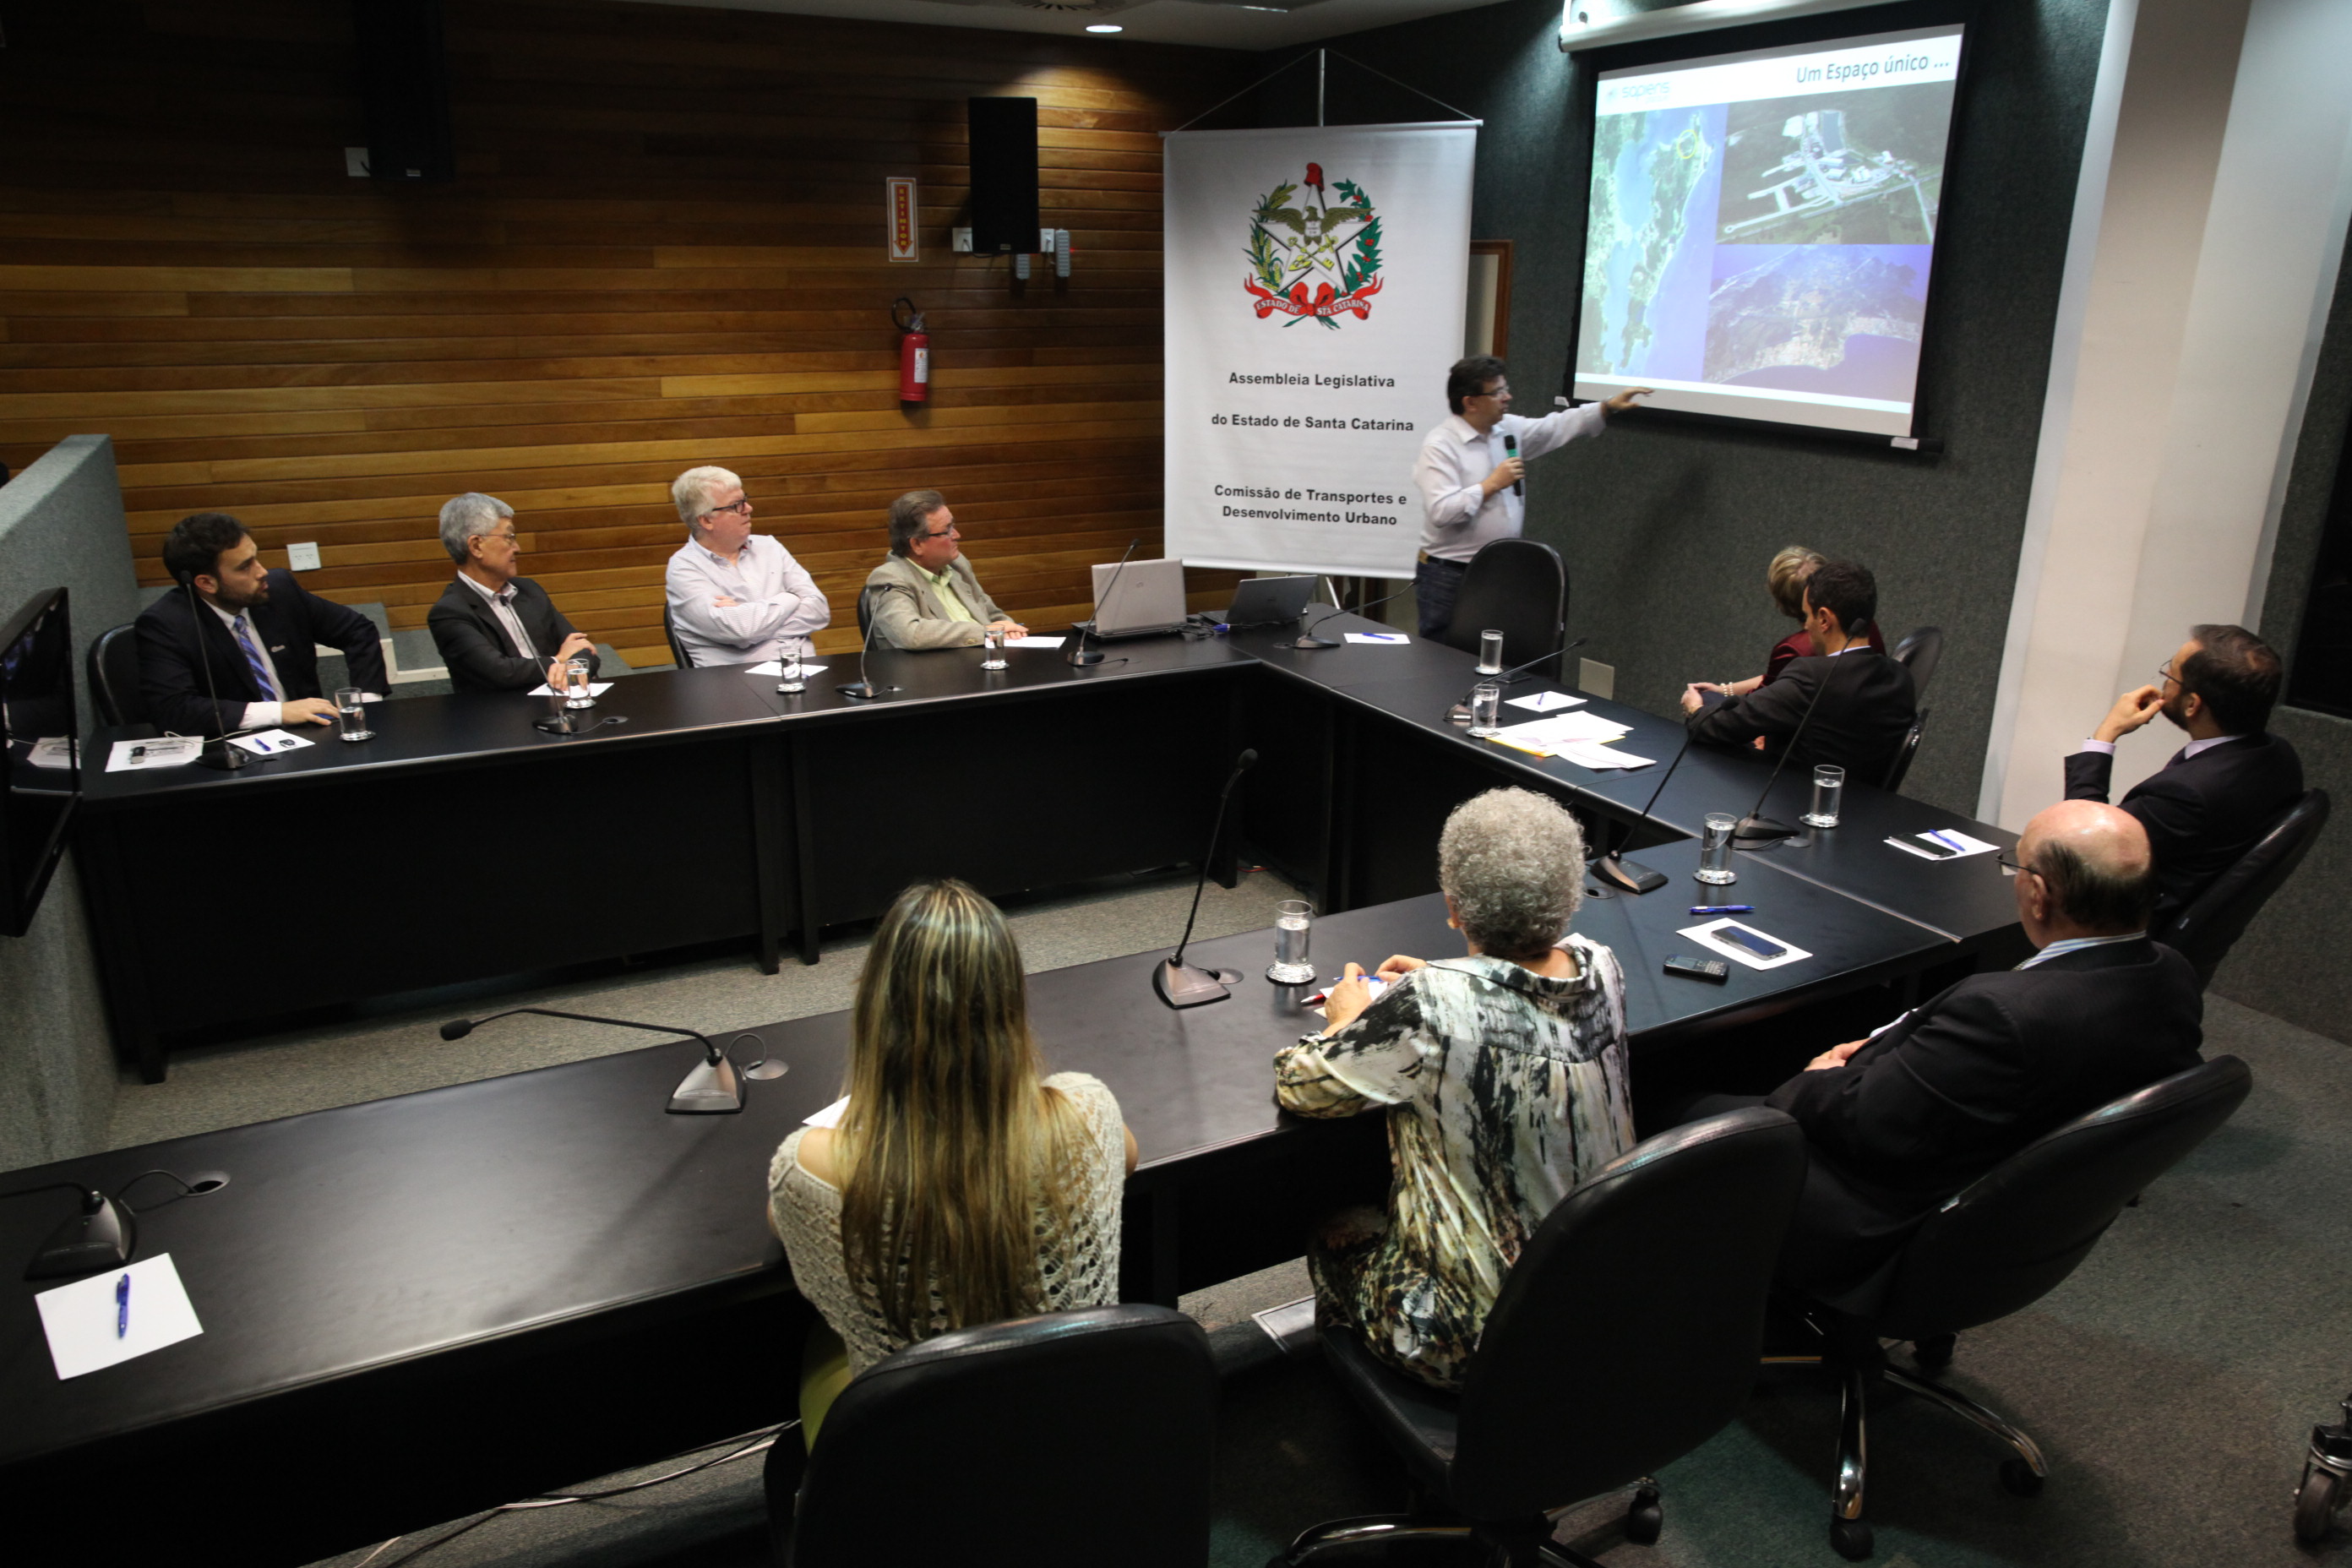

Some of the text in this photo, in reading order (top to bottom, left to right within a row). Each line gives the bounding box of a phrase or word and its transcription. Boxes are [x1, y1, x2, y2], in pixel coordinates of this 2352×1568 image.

[1797, 67, 1821, 83] Um
[1827, 63, 1879, 83] Espaço
[1884, 55, 1929, 74] único
[898, 188, 907, 247] EXTINTOR
[1256, 300, 1288, 310] ESTADO
[1288, 305, 1300, 313] DE
[1333, 299, 1369, 313] CATARINA
[1228, 372, 1395, 389] Assembleia Legislativa
[1211, 414, 1413, 431] do Estado de Santa Catarina
[1214, 484, 1407, 504] Comissão de Transportes e
[1222, 505, 1397, 525] Desenvolvimento Urbano
